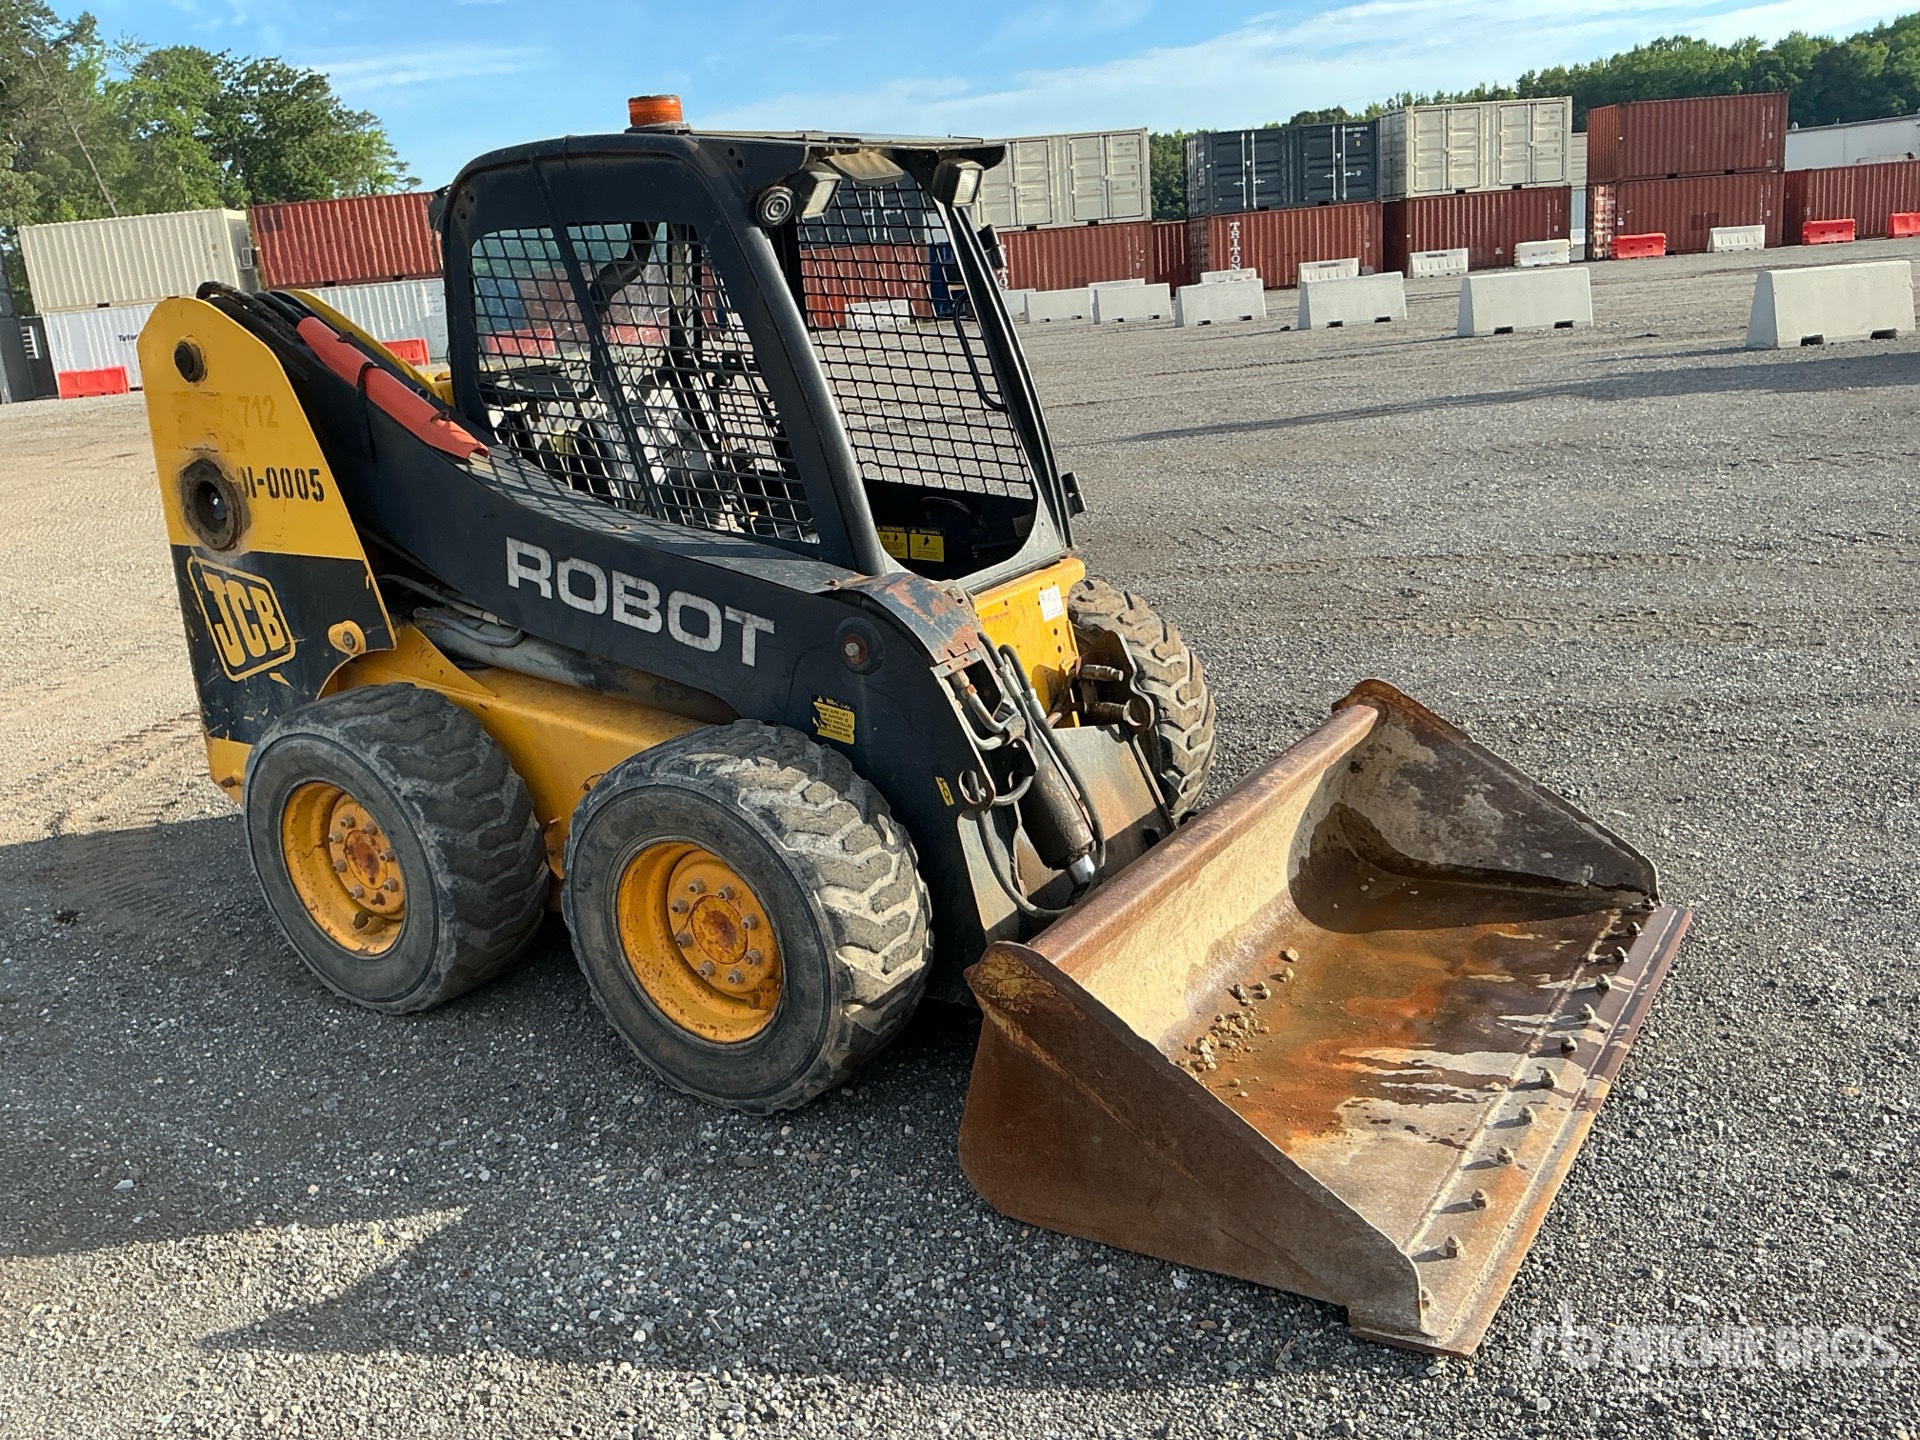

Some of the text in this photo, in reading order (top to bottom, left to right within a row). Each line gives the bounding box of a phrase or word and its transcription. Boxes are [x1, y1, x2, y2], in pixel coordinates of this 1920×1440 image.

[1229, 221, 1242, 270] TRITON
[237, 394, 279, 428] 712
[202, 571, 285, 667] JCB
[506, 536, 775, 668] ROBOT
